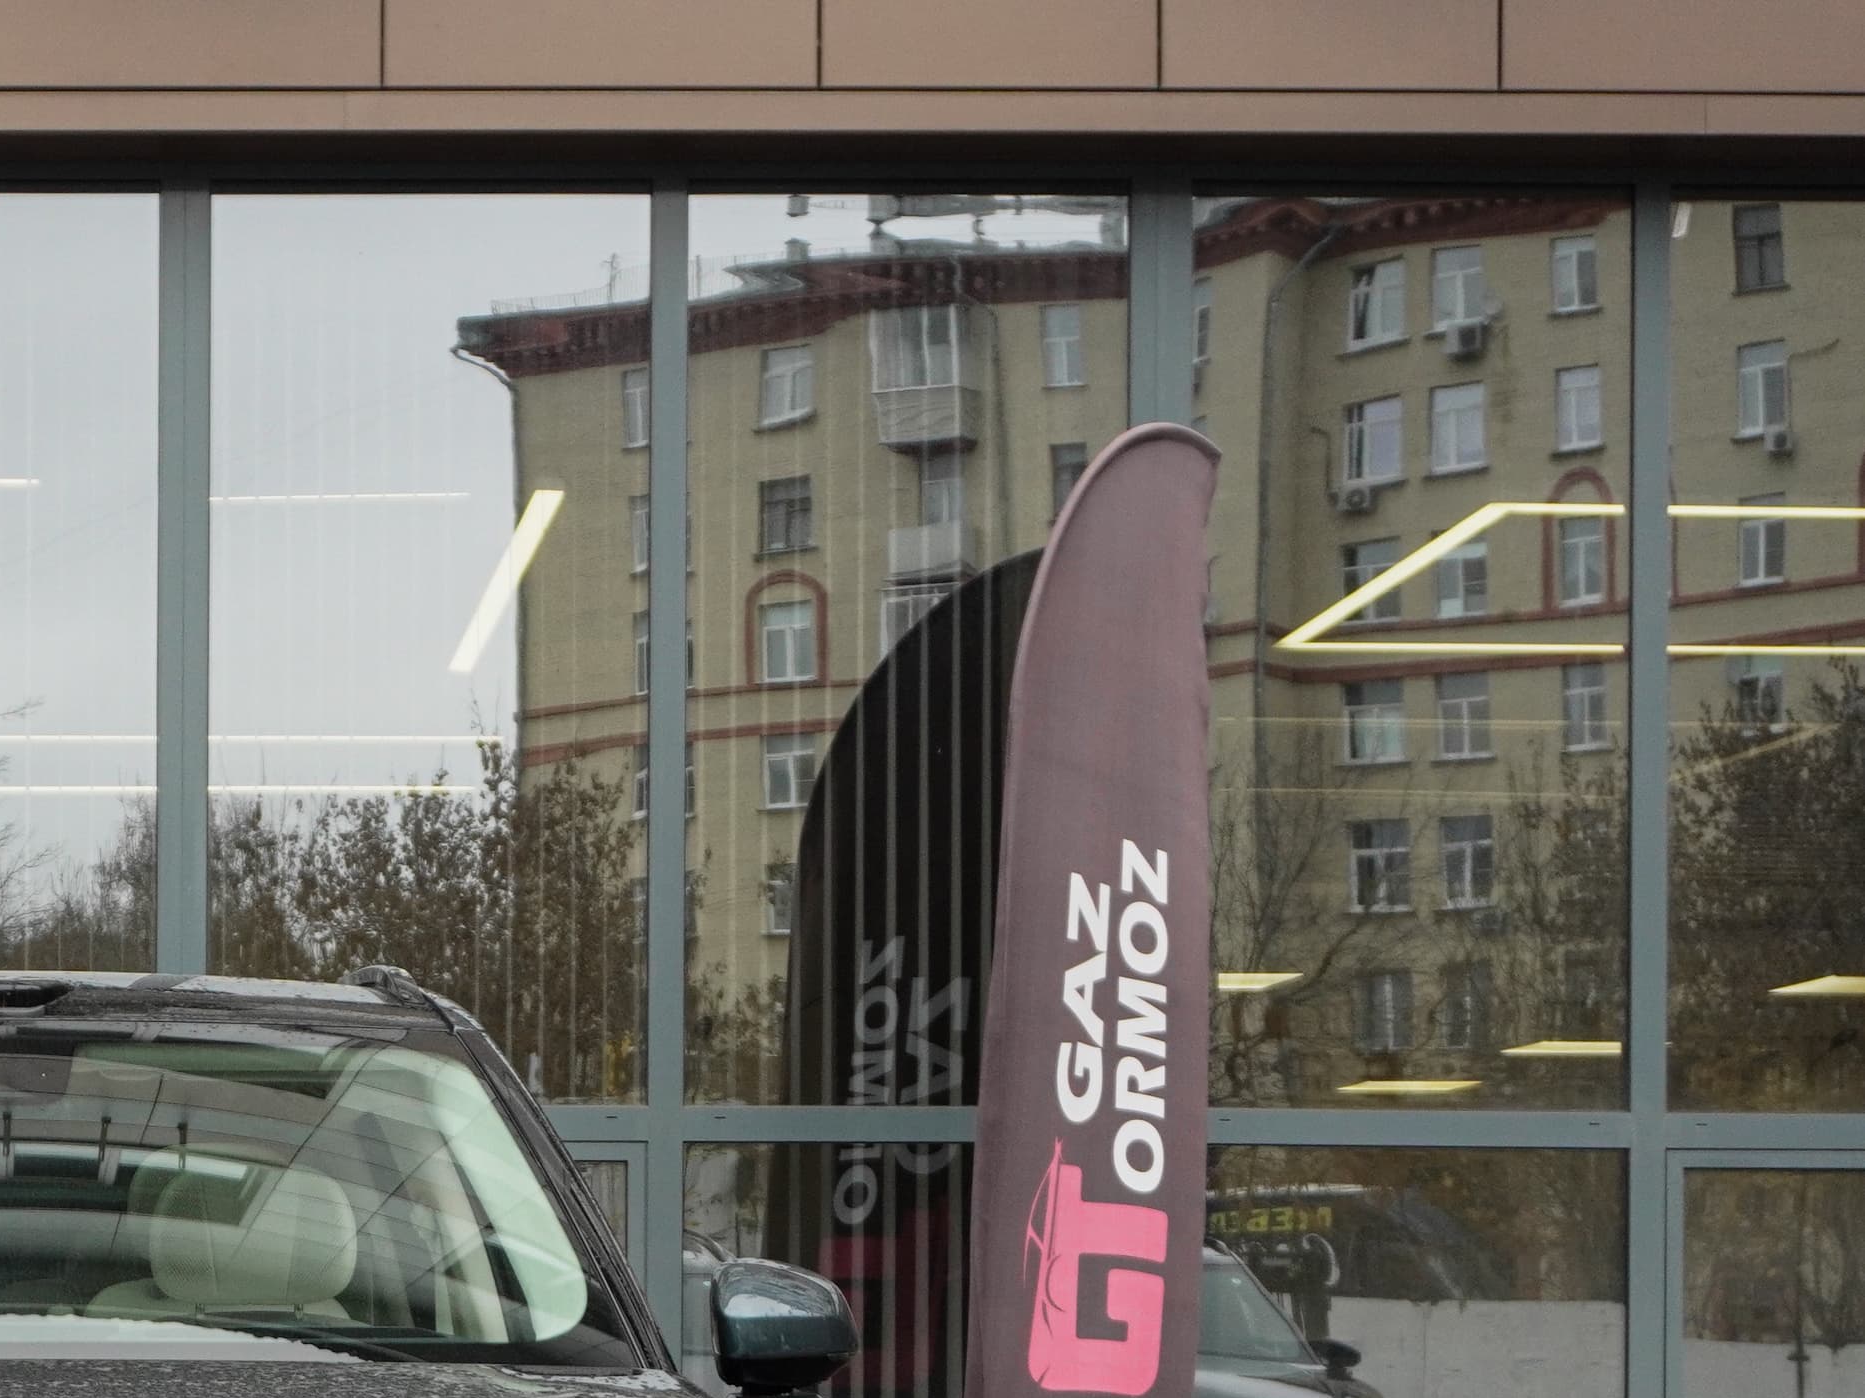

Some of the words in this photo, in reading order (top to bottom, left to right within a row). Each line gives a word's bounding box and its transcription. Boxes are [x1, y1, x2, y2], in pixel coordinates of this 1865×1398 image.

[1056, 871, 1111, 1123] GAZ
[1112, 838, 1169, 1194] ORMOZ
[1024, 1138, 1169, 1397] GT
